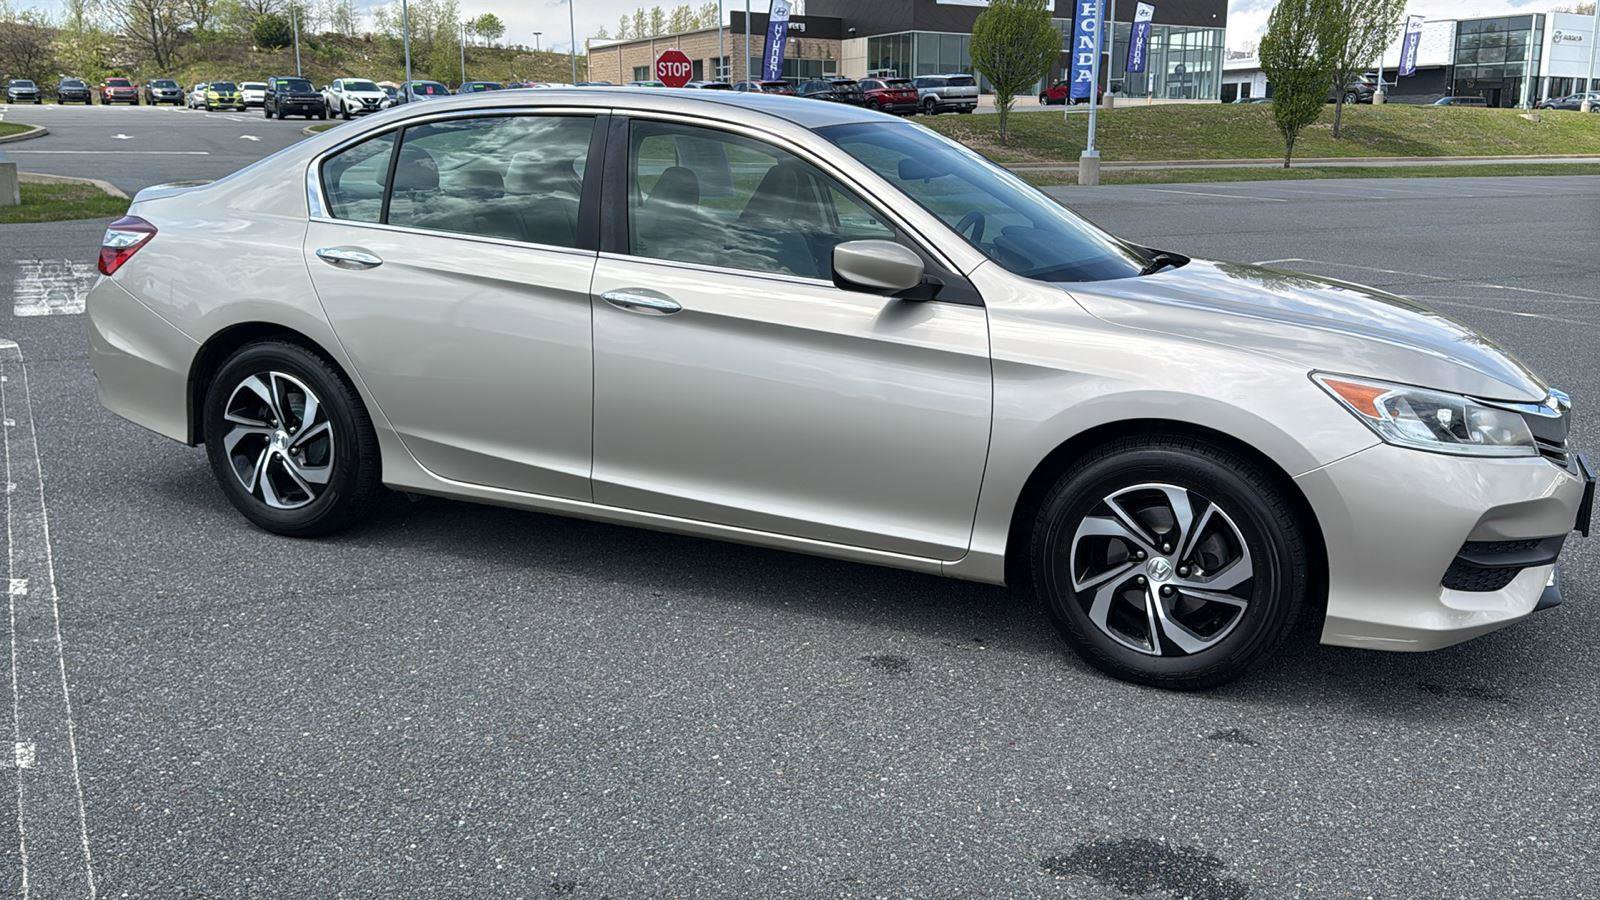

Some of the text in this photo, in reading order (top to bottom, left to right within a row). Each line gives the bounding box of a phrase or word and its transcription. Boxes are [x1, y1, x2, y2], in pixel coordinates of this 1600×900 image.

[770, 24, 783, 79] HYUNDAI
[1074, 2, 1103, 82] HONDA
[1133, 23, 1145, 71] HYUNDAI
[658, 61, 691, 77] STOP
